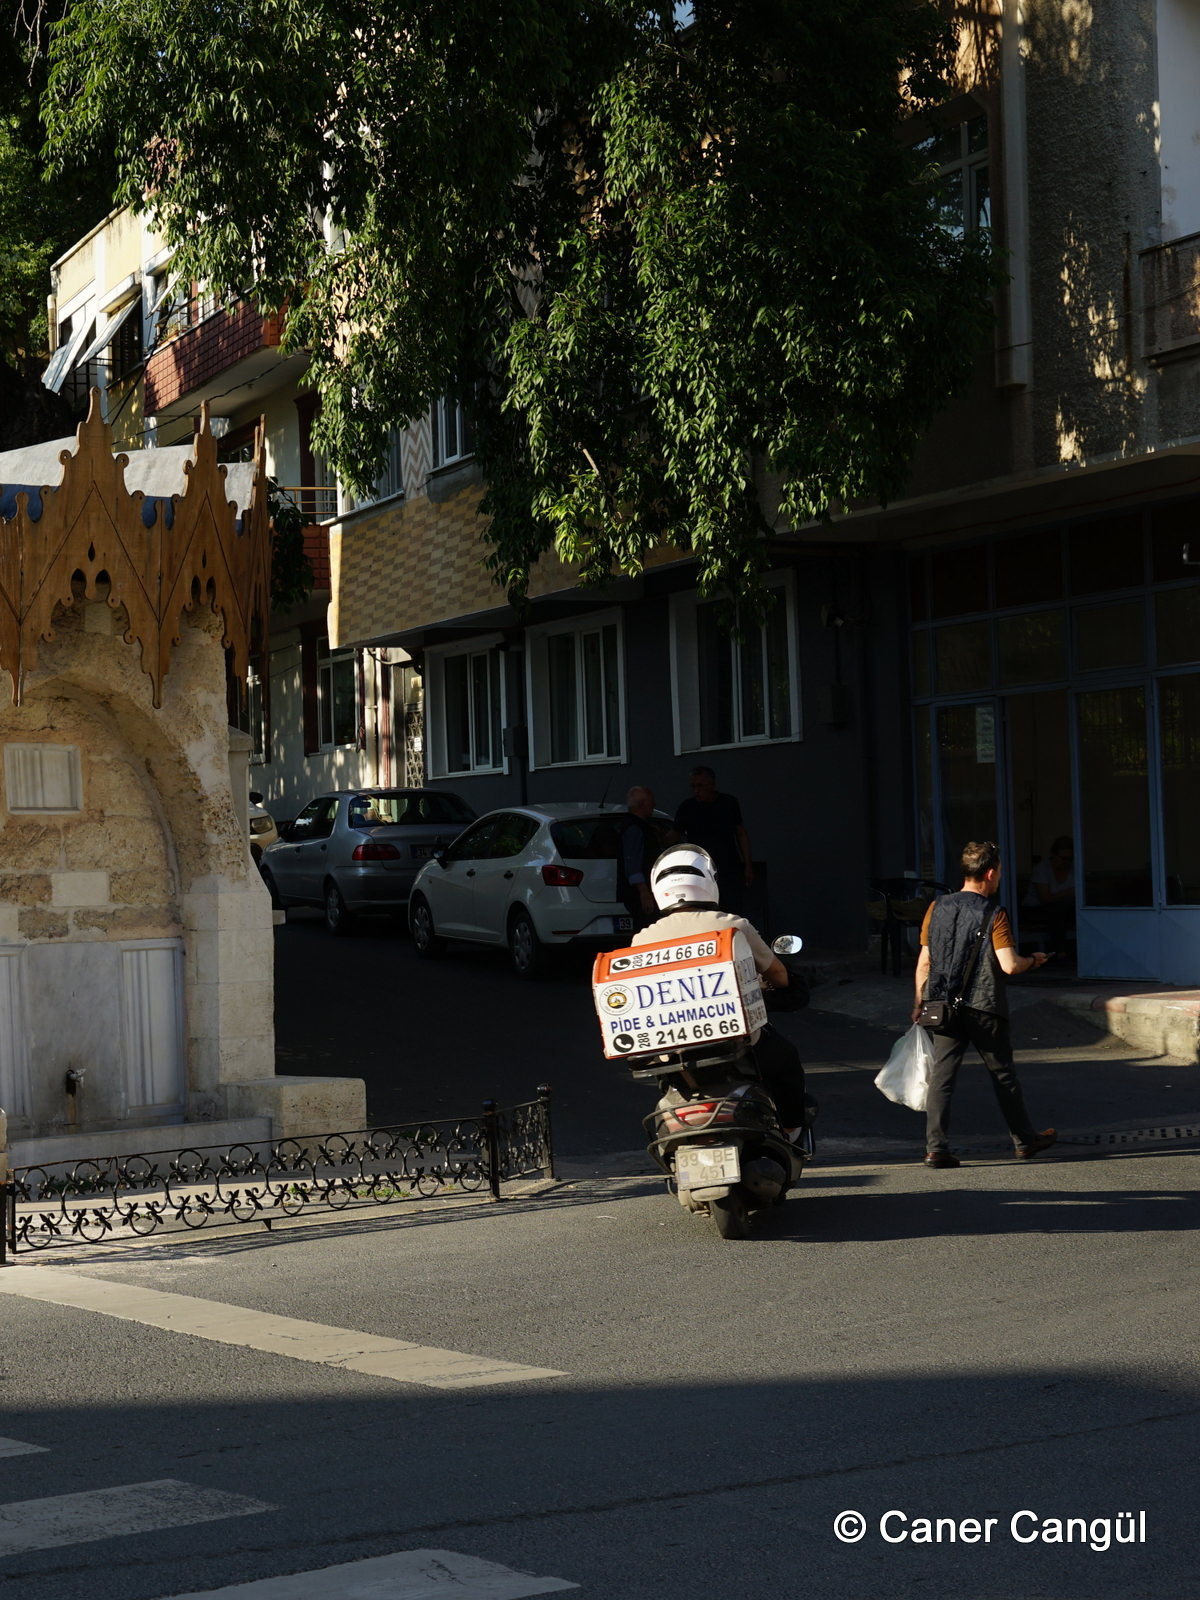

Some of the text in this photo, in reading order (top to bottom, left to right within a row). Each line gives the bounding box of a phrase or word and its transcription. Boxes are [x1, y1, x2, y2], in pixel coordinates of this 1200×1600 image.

[620, 918, 631, 929] 39
[646, 950, 671, 966] 214
[676, 946, 692, 960] 66
[697, 942, 714, 956] 66
[636, 968, 730, 1009] DENİZ
[610, 1017, 641, 1034] PİDE
[646, 1015, 655, 1028] &
[659, 1001, 736, 1026] LAHMACUN
[637, 1019, 740, 1049] 288 214 66 66
[680, 1148, 735, 1168] 39 BE
[700, 1164, 726, 1180] 451
